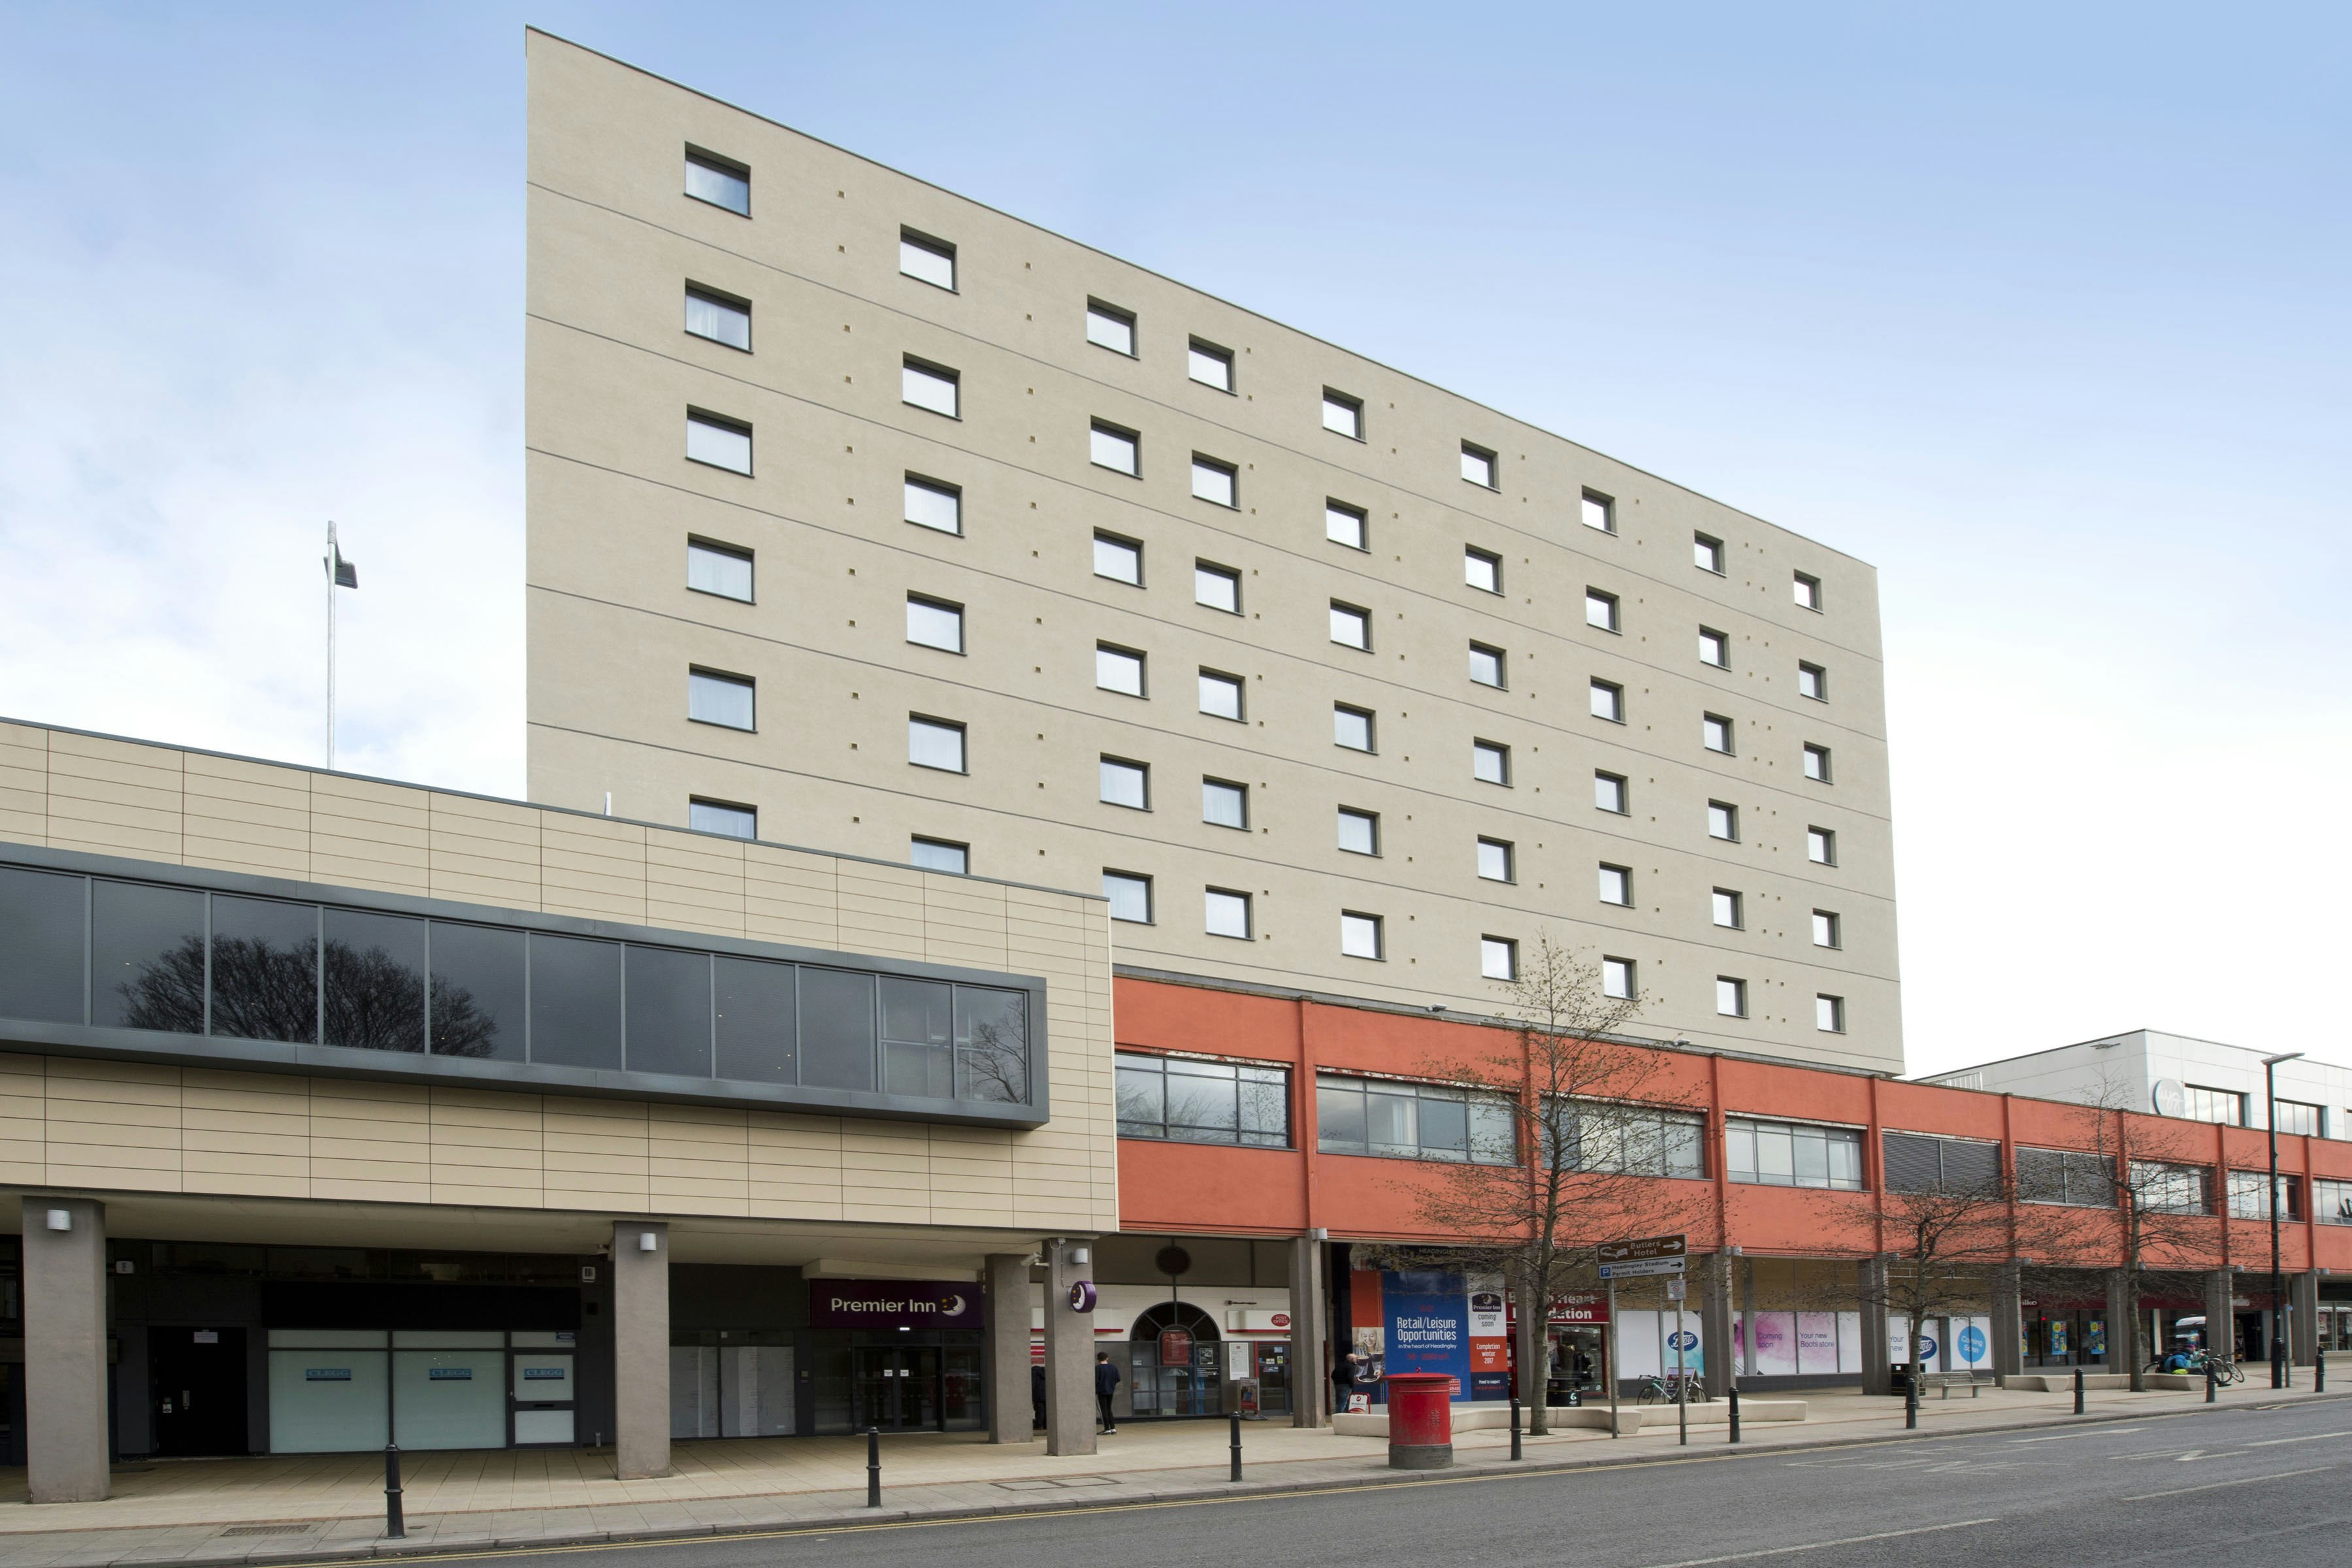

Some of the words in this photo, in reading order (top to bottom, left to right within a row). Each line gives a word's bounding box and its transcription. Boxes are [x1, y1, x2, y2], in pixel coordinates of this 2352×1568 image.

[1634, 1248, 1658, 1256] Hotel
[831, 1298, 905, 1312] Premier
[909, 1299, 936, 1313] Inn
[1397, 1316, 1456, 1329] Retail/Leisure
[1397, 1328, 1457, 1343] Opportunities
[1477, 1343, 1501, 1352] Completion
